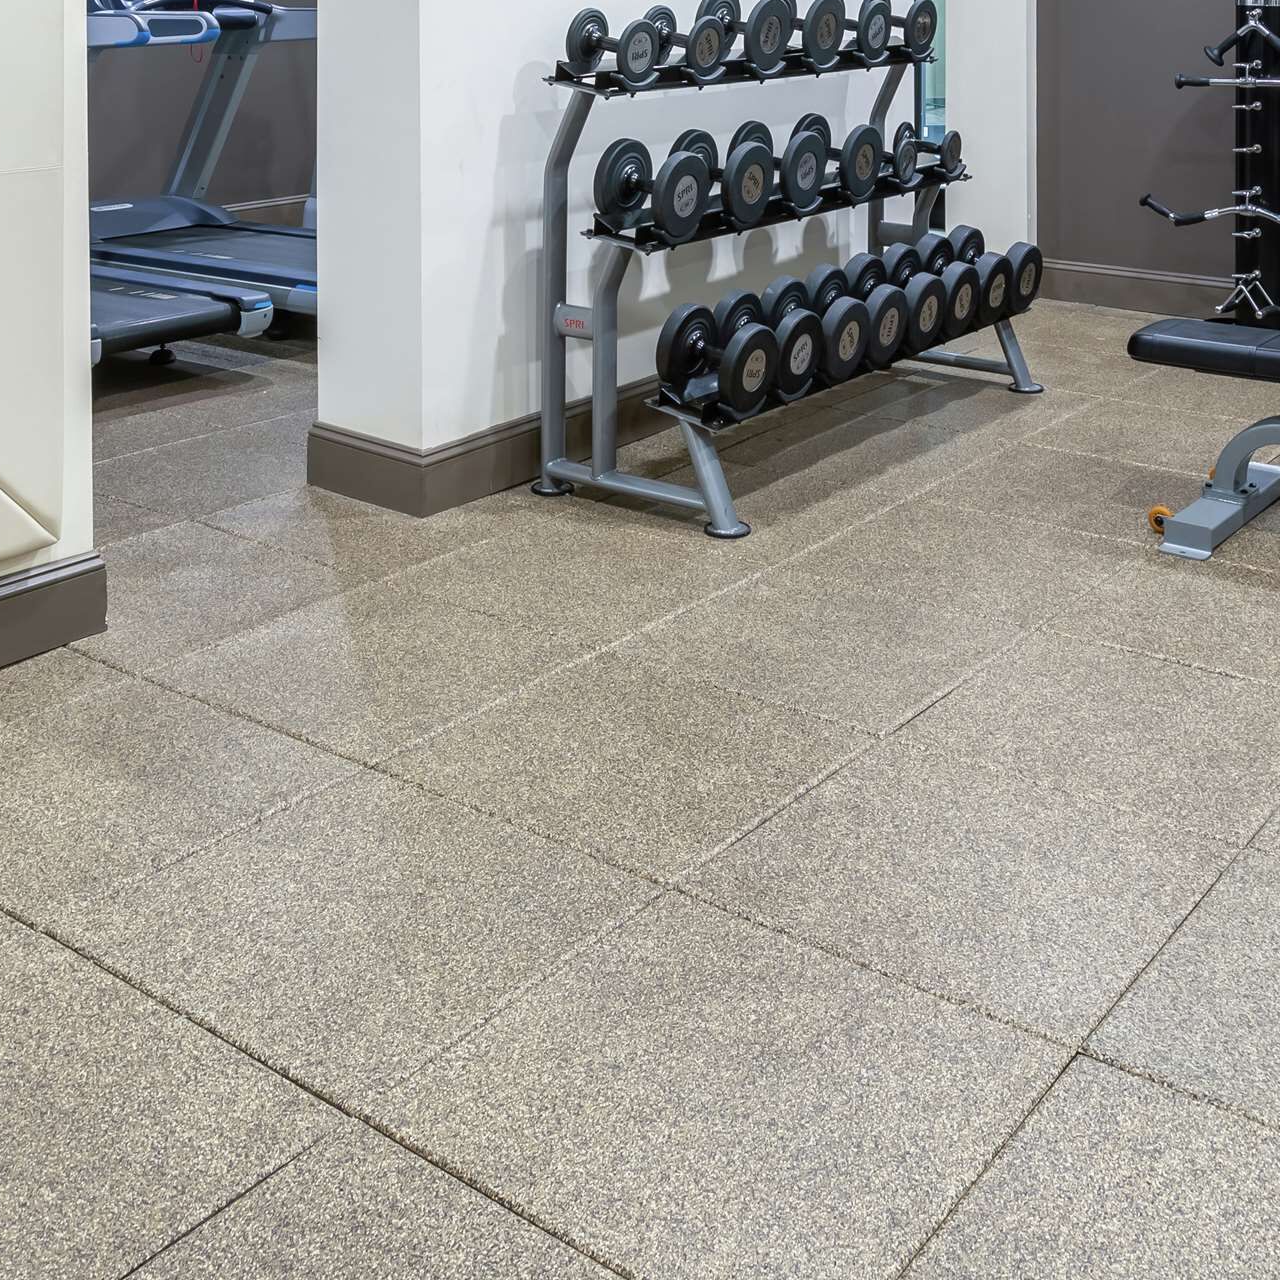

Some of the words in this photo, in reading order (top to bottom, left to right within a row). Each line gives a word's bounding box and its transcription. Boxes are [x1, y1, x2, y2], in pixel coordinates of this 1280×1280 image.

[631, 48, 648, 61] SPRI
[677, 184, 694, 202] SPRI
[564, 319, 584, 329] SPRI
[793, 341, 809, 362] SPRI
[746, 369, 762, 379] SPRI
